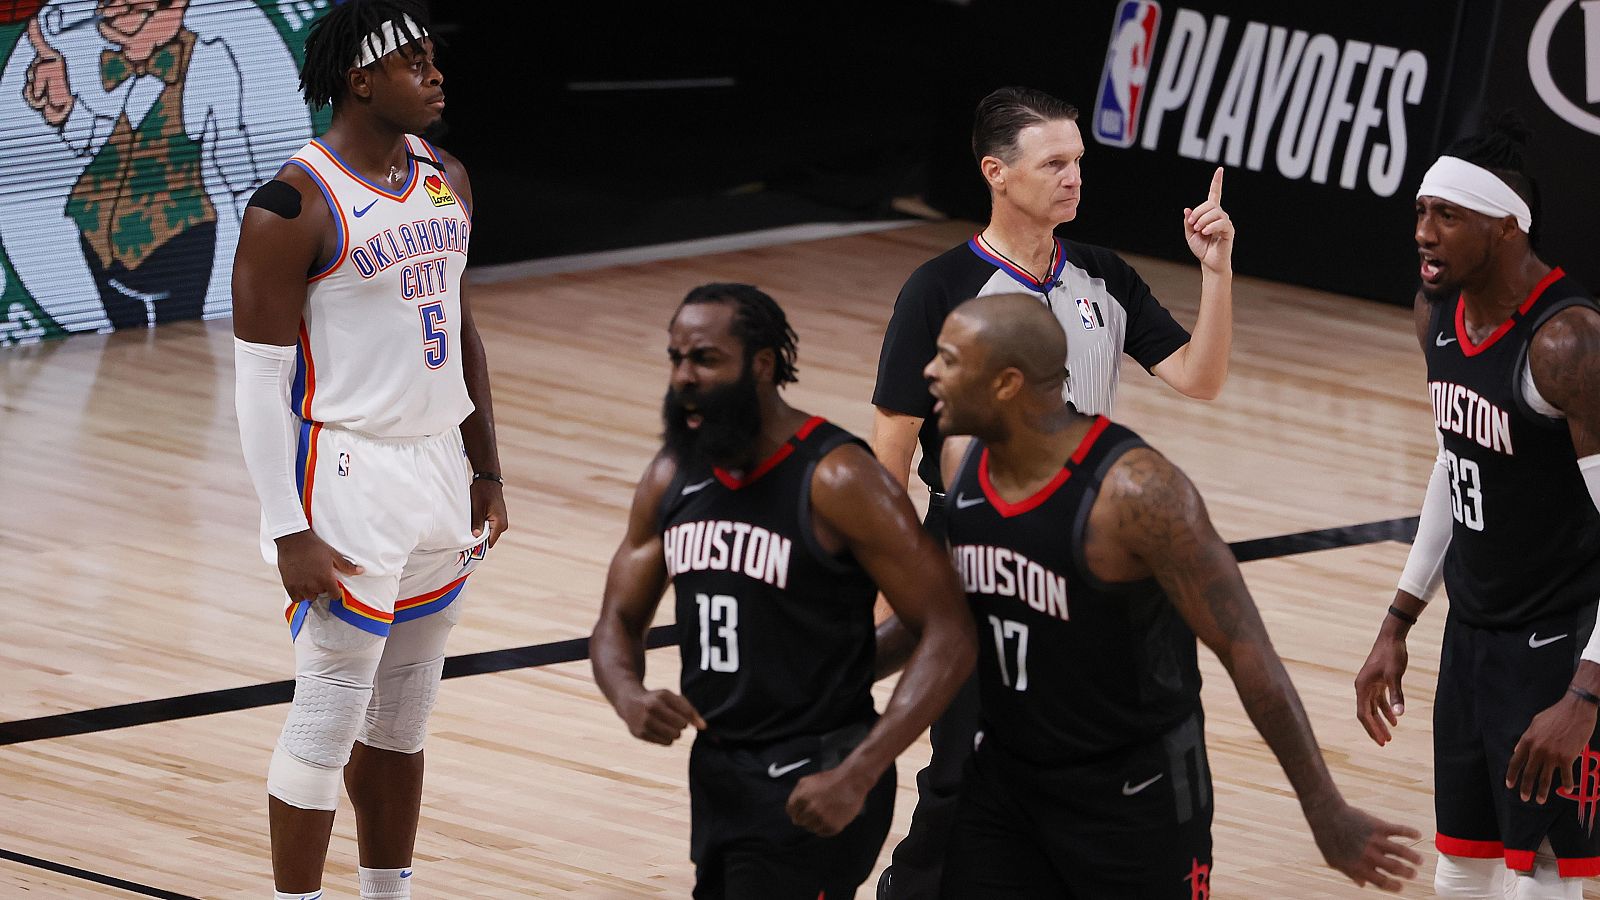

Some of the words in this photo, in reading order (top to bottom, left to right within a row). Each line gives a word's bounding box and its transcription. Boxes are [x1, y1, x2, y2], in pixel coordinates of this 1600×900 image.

[1141, 7, 1428, 198] PLAYOFFS
[350, 217, 469, 279] OKLAHOMA
[400, 257, 447, 301] CITY
[417, 300, 449, 370] 5
[1428, 381, 1514, 455] OUSTON
[1446, 449, 1485, 532] 33
[663, 520, 792, 590] HOUSTON
[695, 593, 740, 673] 13
[987, 614, 1029, 692] 17
